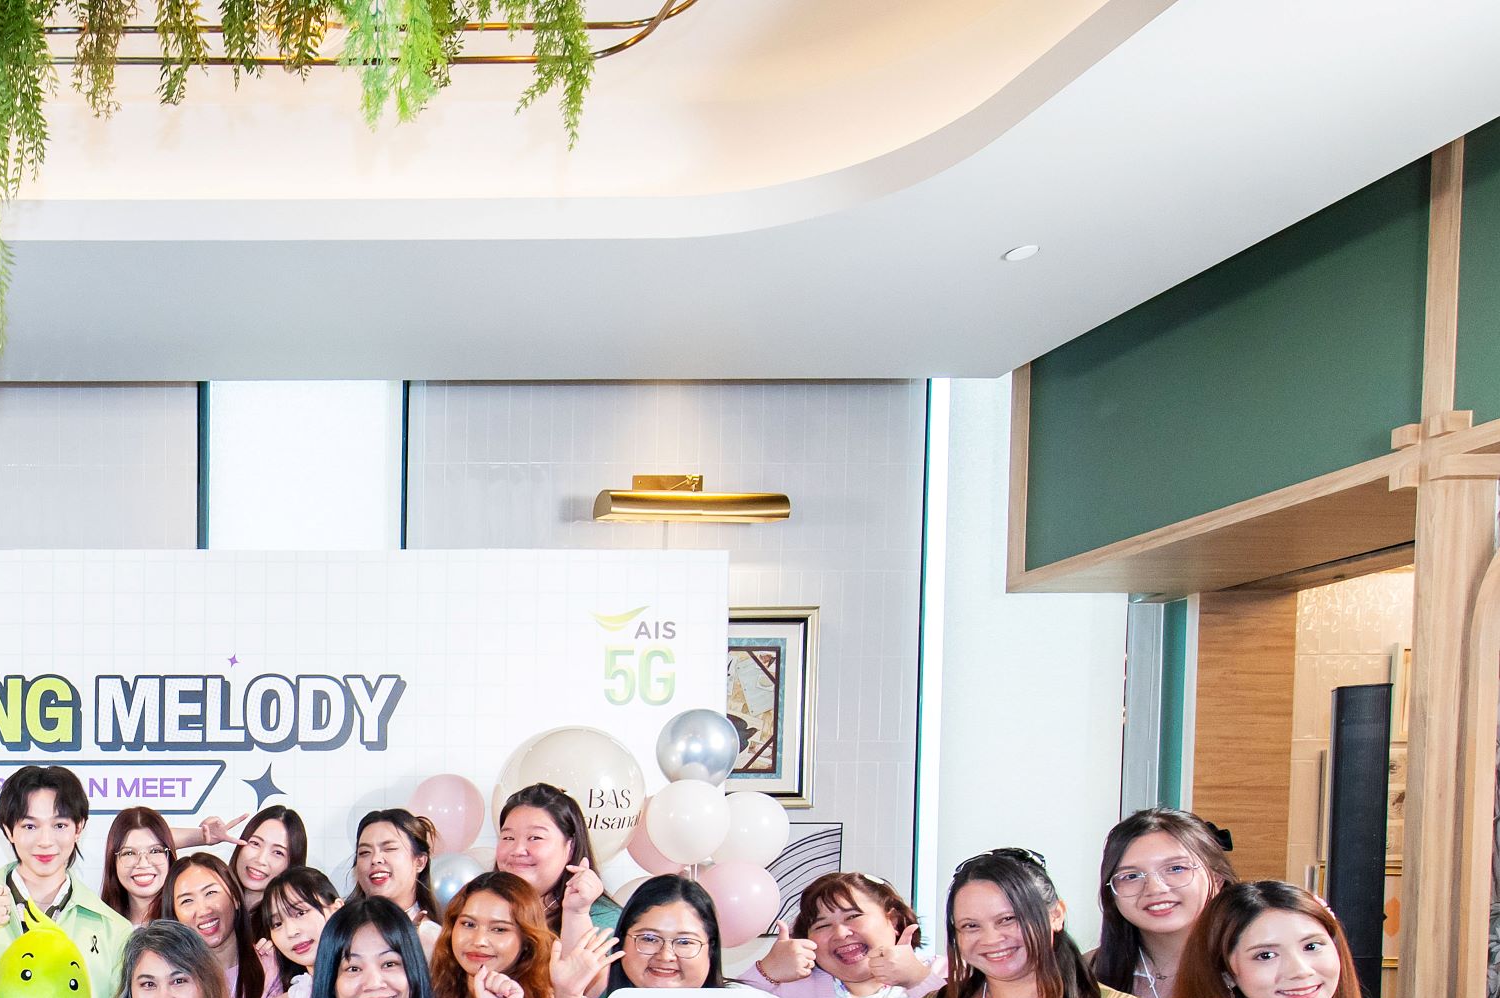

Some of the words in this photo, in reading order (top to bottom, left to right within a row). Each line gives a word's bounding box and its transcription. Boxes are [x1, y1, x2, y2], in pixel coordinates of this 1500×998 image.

[634, 621, 676, 640] AIS
[604, 645, 676, 706] 5G
[95, 673, 407, 752] MELODY
[117, 777, 192, 797] MEET
[589, 788, 631, 809] BAS
